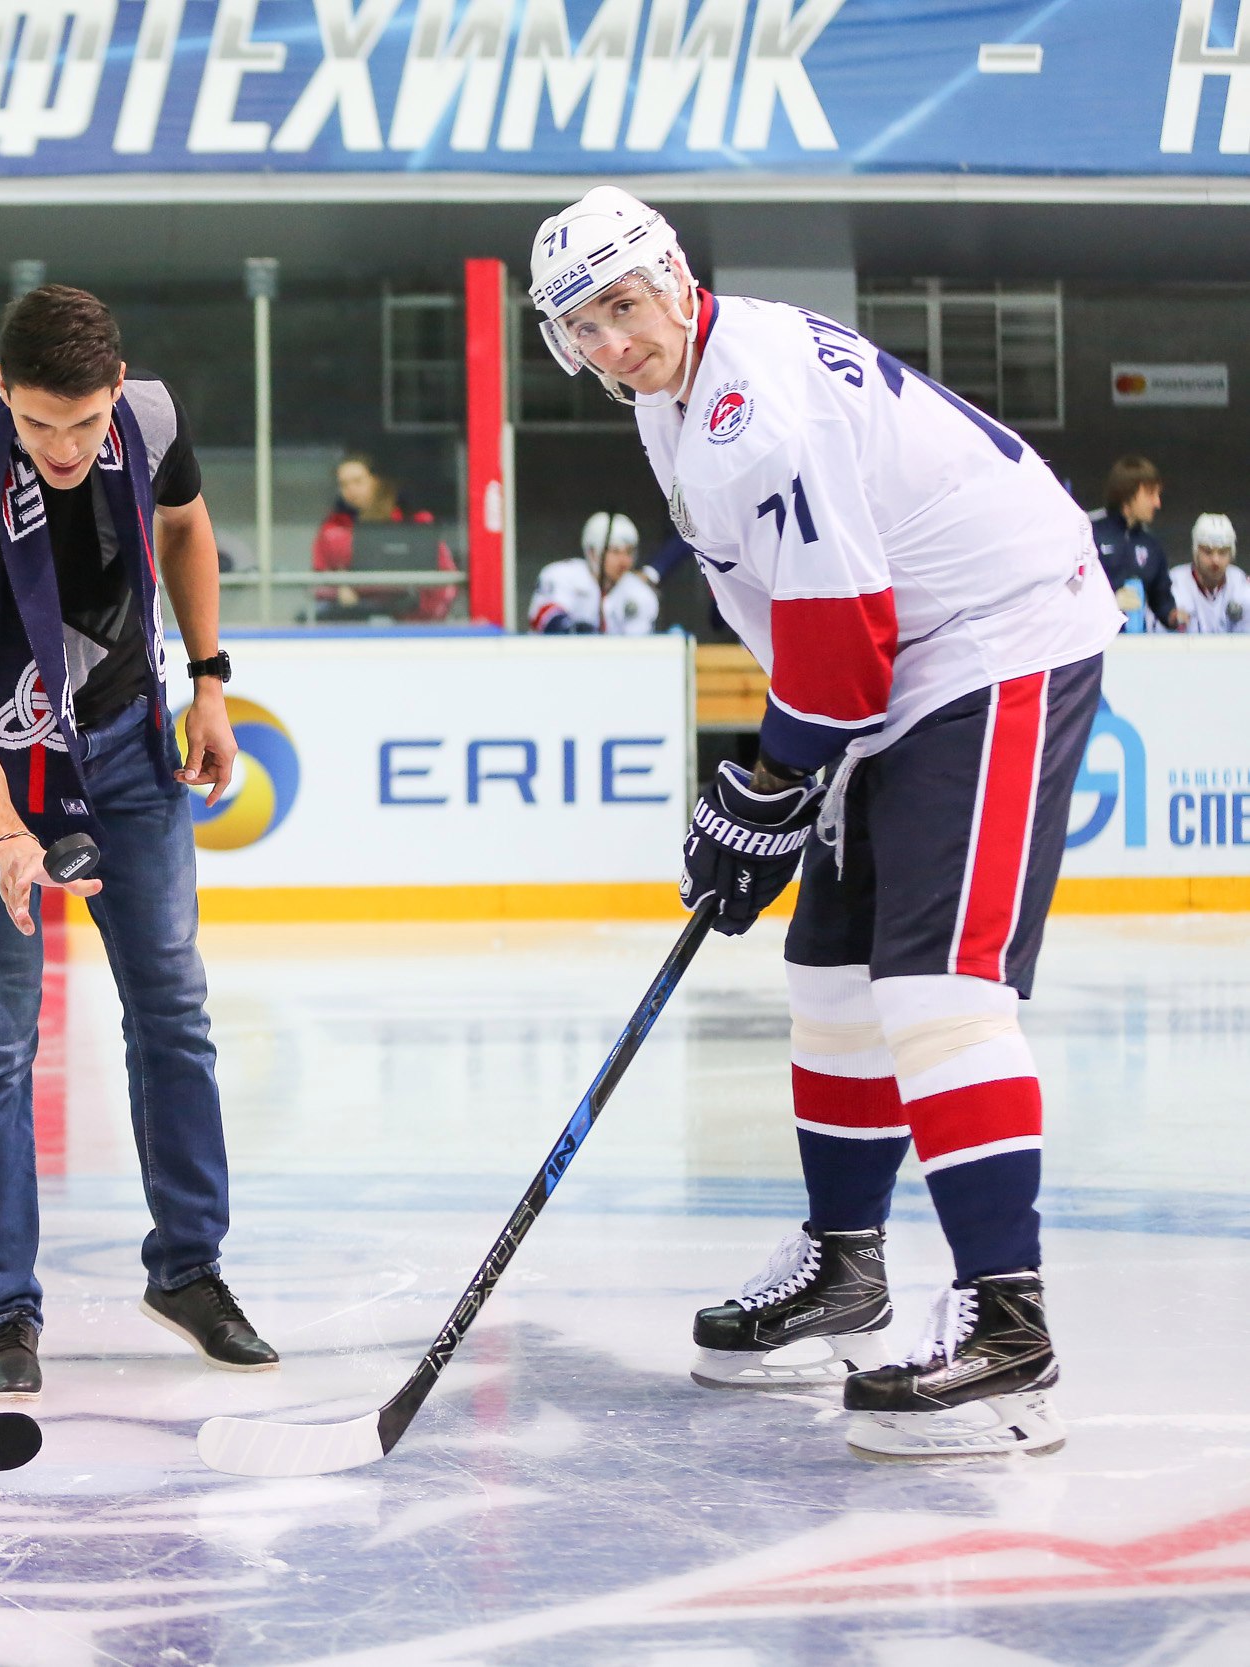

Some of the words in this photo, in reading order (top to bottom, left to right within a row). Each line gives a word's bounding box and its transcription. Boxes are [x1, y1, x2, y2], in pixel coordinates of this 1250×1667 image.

[543, 226, 568, 258] 71
[545, 263, 587, 296] СОГАЗ
[757, 471, 819, 544] 71
[379, 737, 671, 804] ERIE
[693, 797, 812, 856] WARRIOR
[787, 1307, 823, 1328] BAUER
